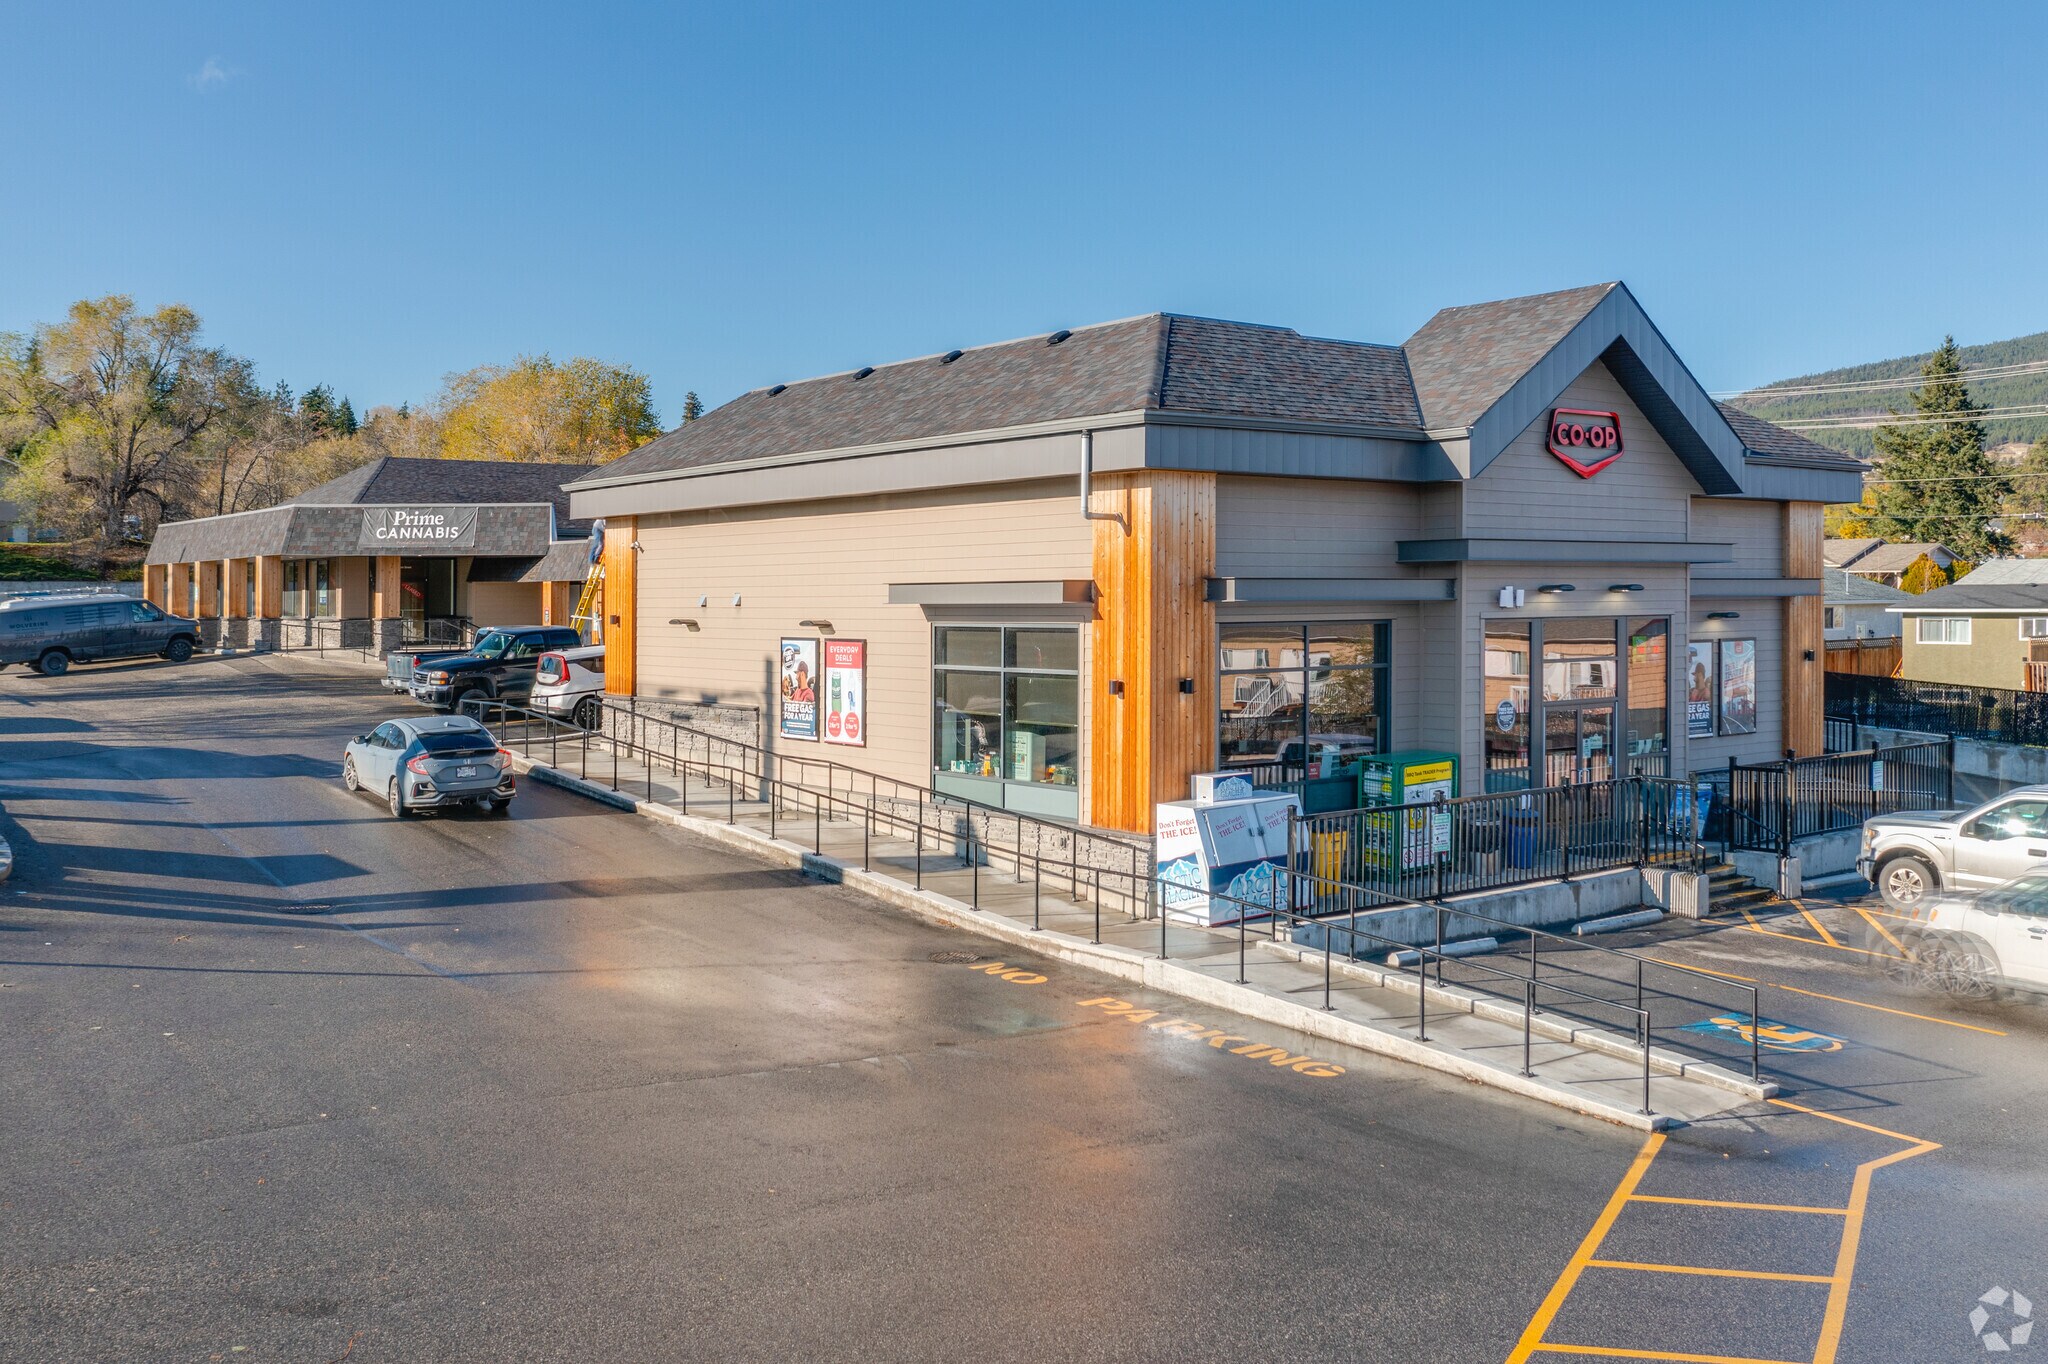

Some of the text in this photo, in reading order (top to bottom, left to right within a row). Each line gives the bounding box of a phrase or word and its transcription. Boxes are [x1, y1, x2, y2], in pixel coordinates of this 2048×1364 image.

[393, 510, 444, 526] Prime
[376, 526, 459, 539] CANNABIS
[9, 621, 49, 630] WOLVERINE
[829, 645, 859, 654] EVERYDAY
[834, 654, 853, 662] DEALS
[784, 703, 814, 714] FREE GAS
[1697, 703, 1710, 712] GAS
[784, 711, 814, 722] FOR A YEAR
[1696, 712, 1710, 720] YEAR
[1264, 812, 1276, 822] Don't
[1158, 818, 1195, 829] Don't Forget
[1215, 815, 1243, 831] Don't Forget
[1267, 819, 1280, 829] THE
[1160, 826, 1198, 839] THE ICE!
[1218, 820, 1247, 838] THE ICE!
[967, 961, 1049, 985] NO
[1076, 996, 1347, 1078] PARKING
